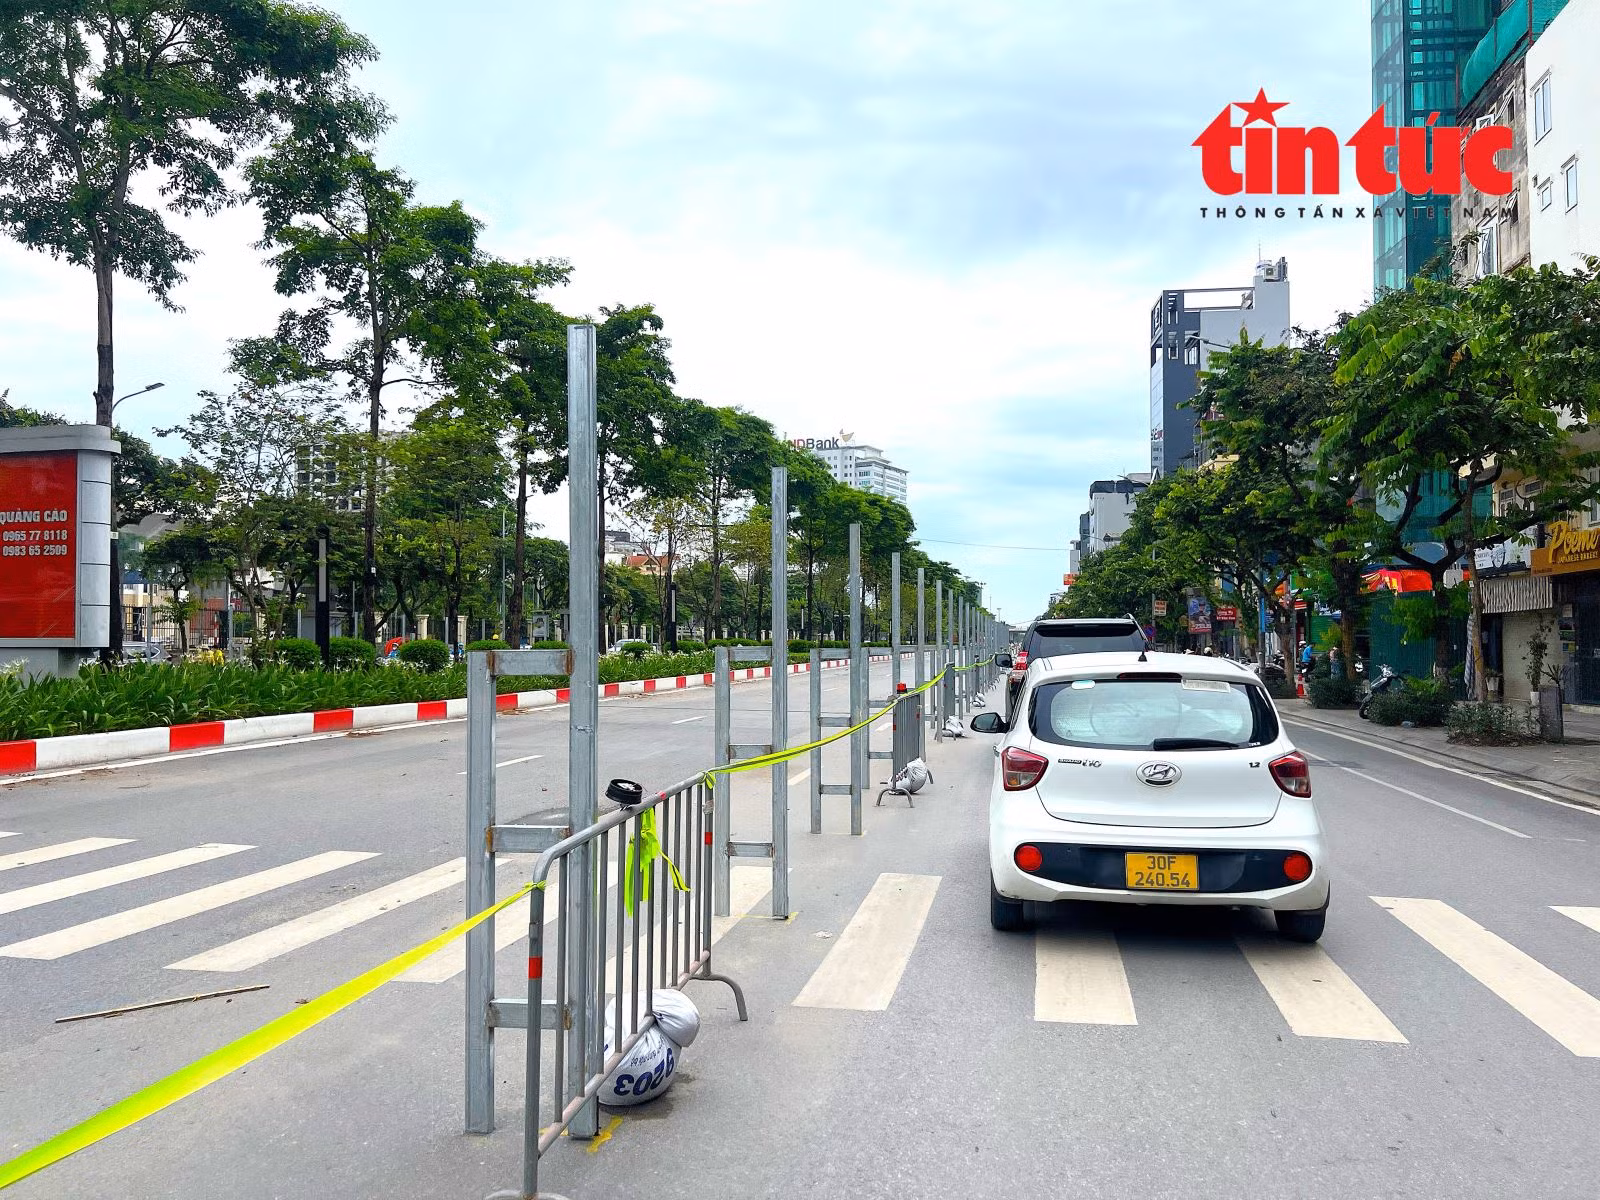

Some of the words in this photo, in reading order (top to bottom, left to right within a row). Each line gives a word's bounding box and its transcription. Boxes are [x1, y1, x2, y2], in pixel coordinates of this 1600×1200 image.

[0, 508, 40, 525] QUẢNG
[43, 508, 67, 522] CÁO
[3, 531, 26, 541] 0965
[29, 530, 41, 541] 77
[43, 530, 67, 541] 8118
[3, 545, 26, 556] 0983
[29, 545, 41, 556] 65
[43, 544, 67, 556] 2509
[1146, 855, 1177, 870] 30F
[1135, 871, 1190, 887] 240.54
[613, 1047, 675, 1096] 9203
